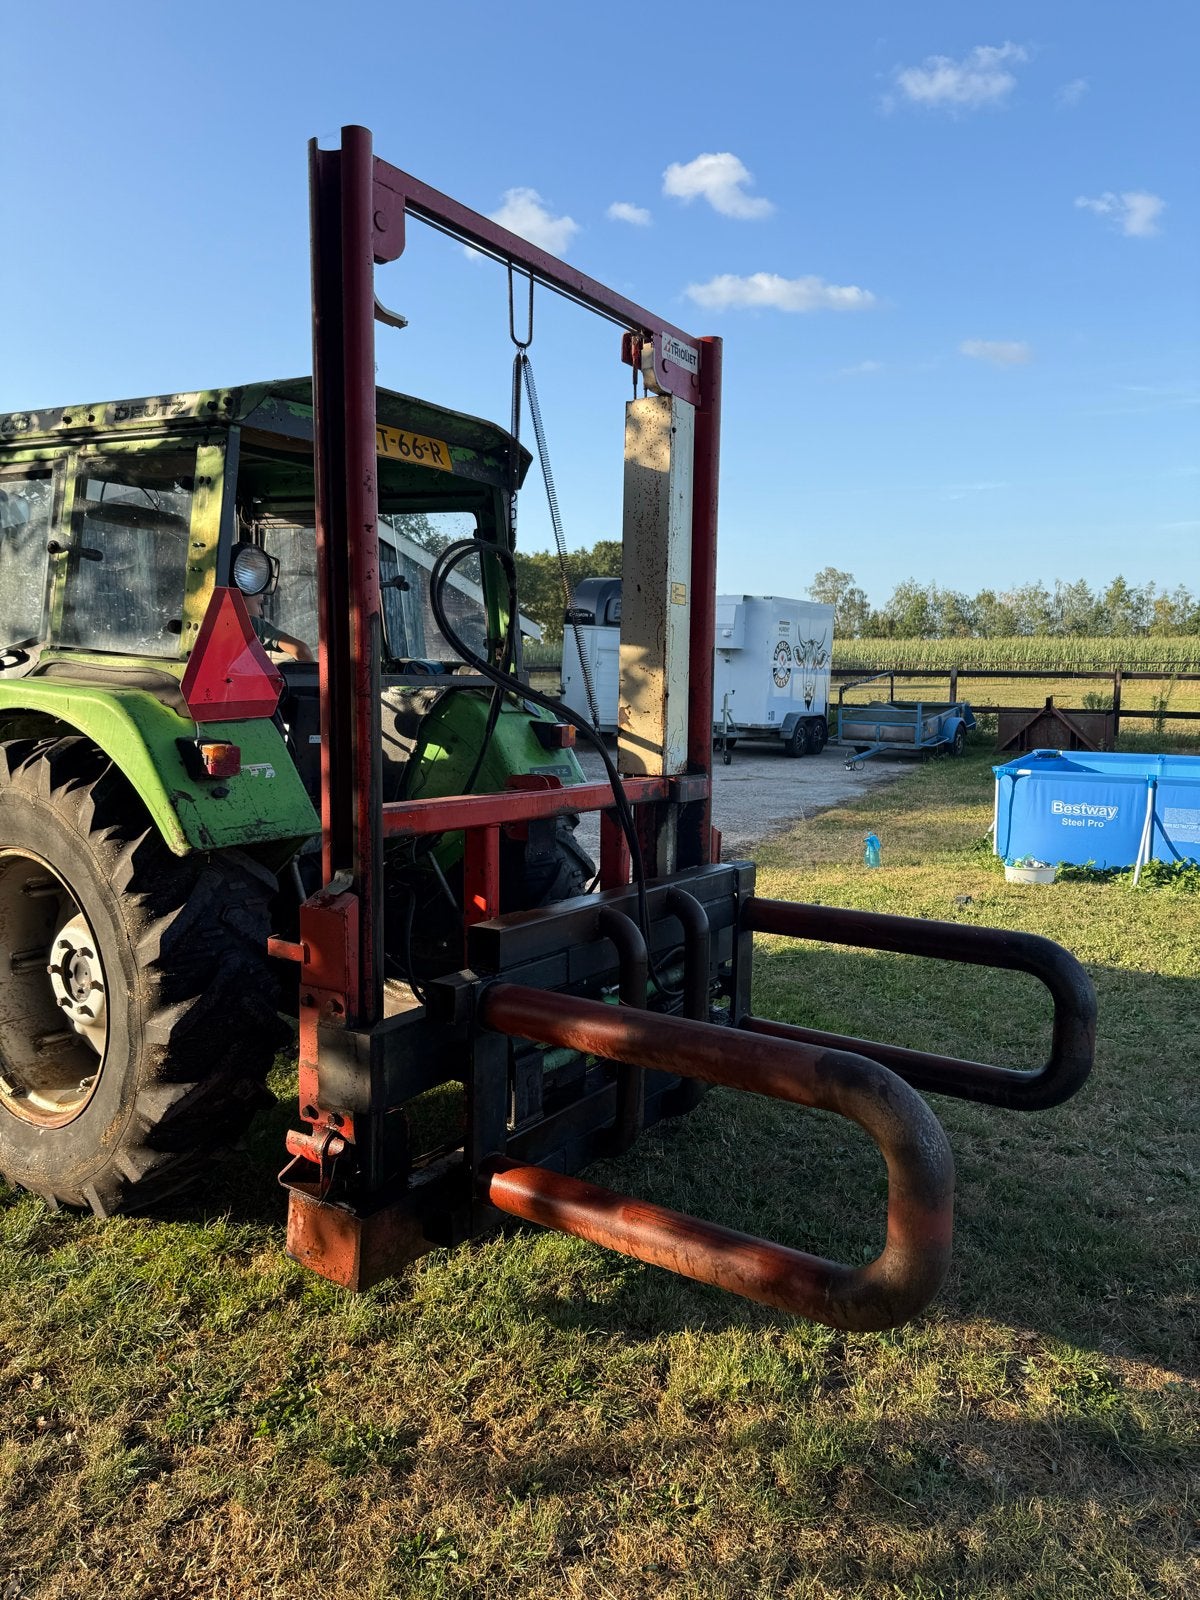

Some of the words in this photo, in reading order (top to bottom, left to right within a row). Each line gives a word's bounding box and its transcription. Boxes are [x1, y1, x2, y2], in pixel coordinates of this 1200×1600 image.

[113, 401, 187, 421] DEUTZ
[376, 427, 445, 465] T-66-R
[1051, 800, 1118, 820] Bestway
[1061, 817, 1085, 827] Steel
[1087, 819, 1105, 828] Pro
